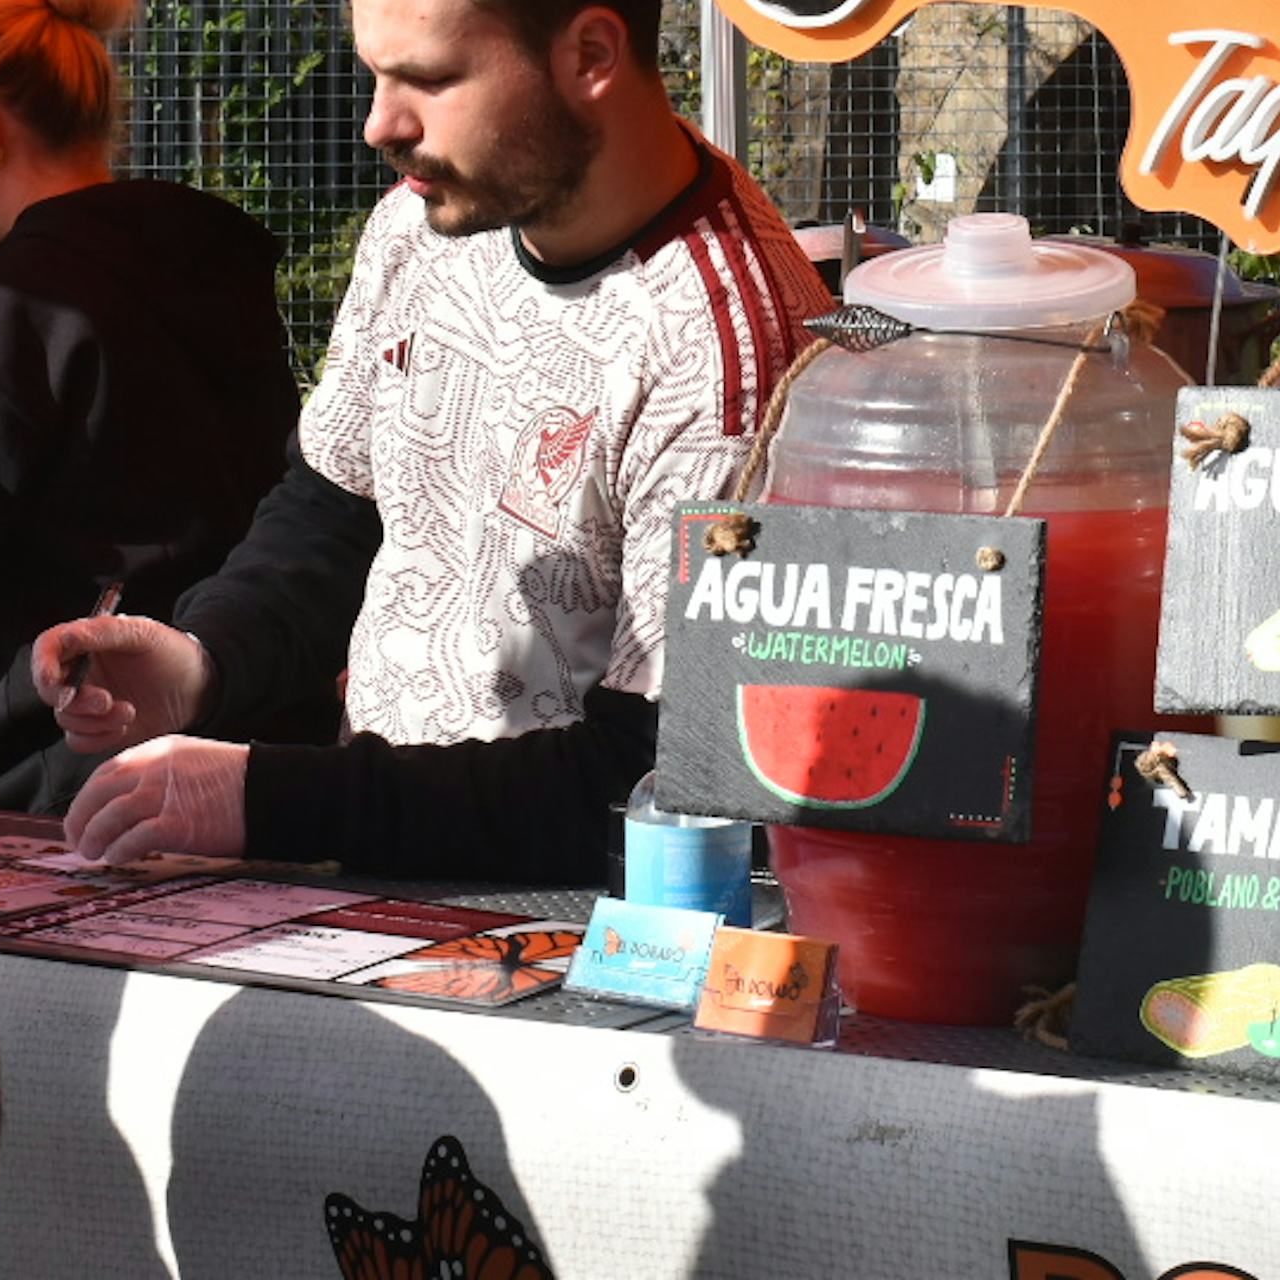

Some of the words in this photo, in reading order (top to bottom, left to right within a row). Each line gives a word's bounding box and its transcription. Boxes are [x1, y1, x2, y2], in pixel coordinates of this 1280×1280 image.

[684, 557, 832, 629] AGUA
[840, 566, 1005, 645] FRESCA
[747, 631, 907, 671] WATERMELON
[1164, 866, 1259, 910] POBLANO
[1262, 883, 1280, 911] &
